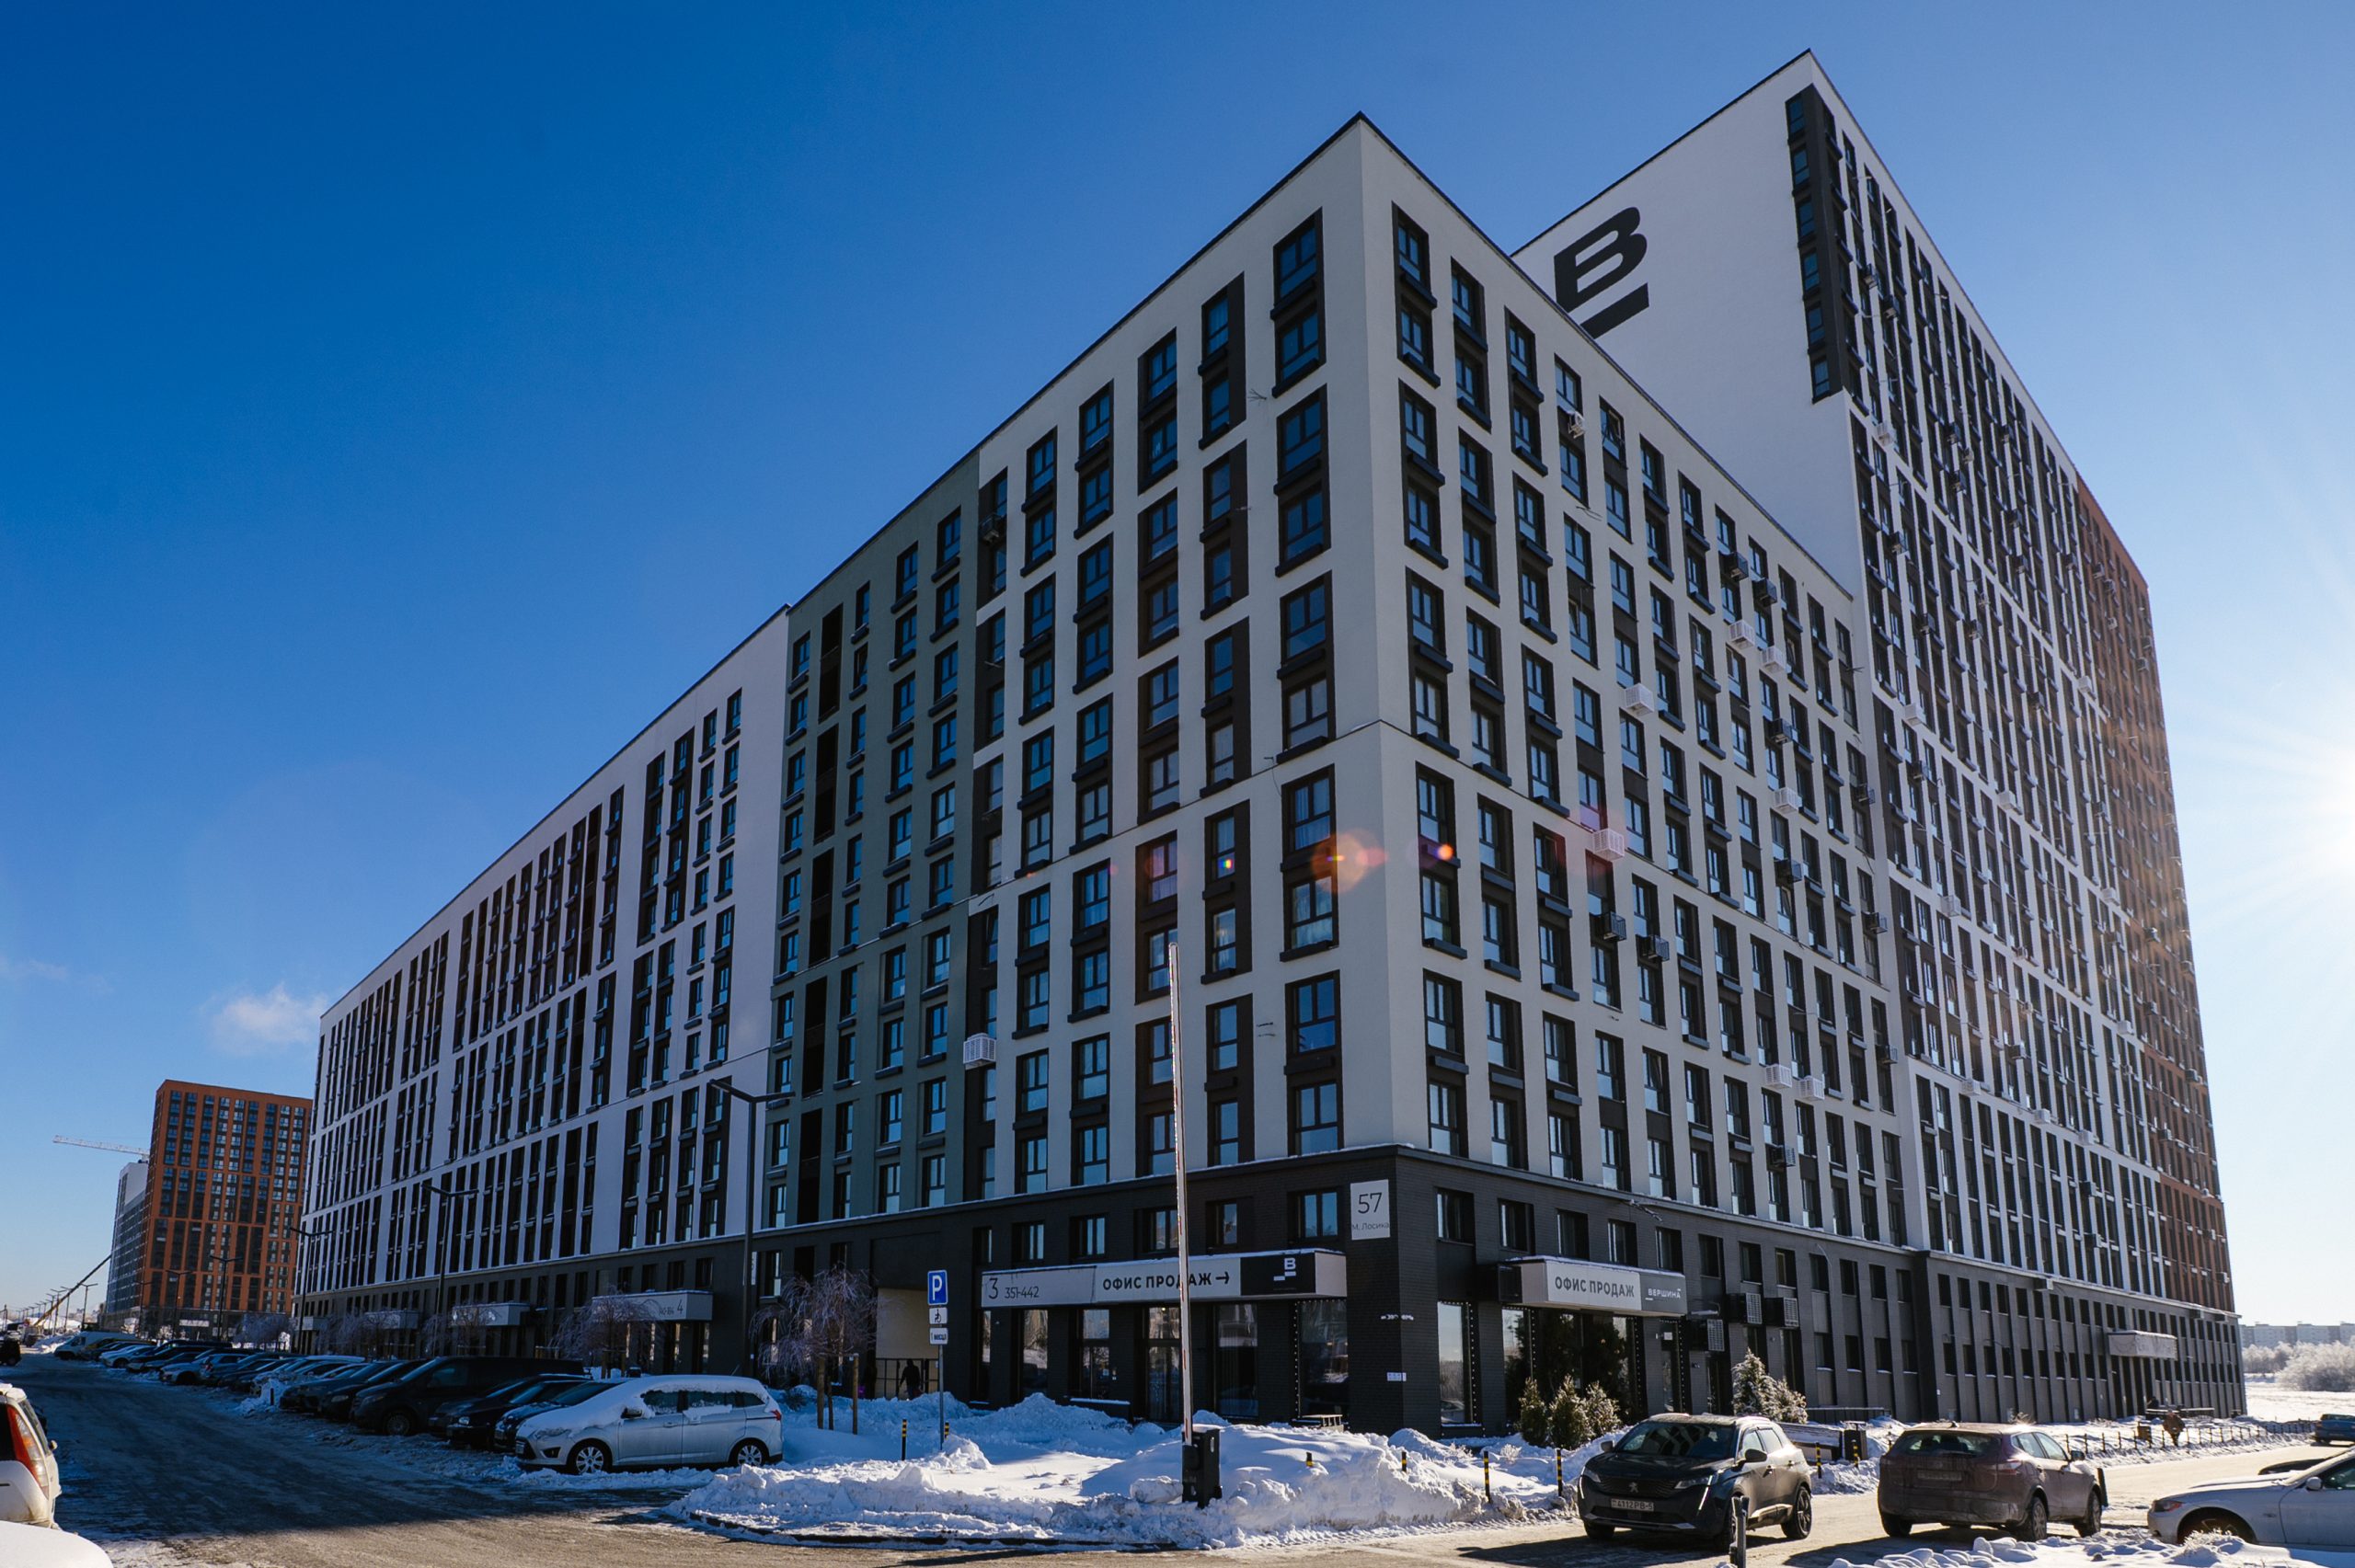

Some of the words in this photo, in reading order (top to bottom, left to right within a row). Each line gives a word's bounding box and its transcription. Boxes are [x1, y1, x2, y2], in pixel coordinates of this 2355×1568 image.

[1358, 1192, 1383, 1214] 57
[1361, 1221, 1390, 1230] Лосика
[932, 1275, 943, 1301] P
[988, 1277, 999, 1299] 3
[1103, 1276, 1143, 1290] ОФИС
[1146, 1272, 1212, 1289] ПРОАЖ
[1555, 1276, 1587, 1292] ОФИС
[1589, 1279, 1635, 1298] ПРОДАЖ
[1648, 1288, 1682, 1299] ВЕРШИНА
